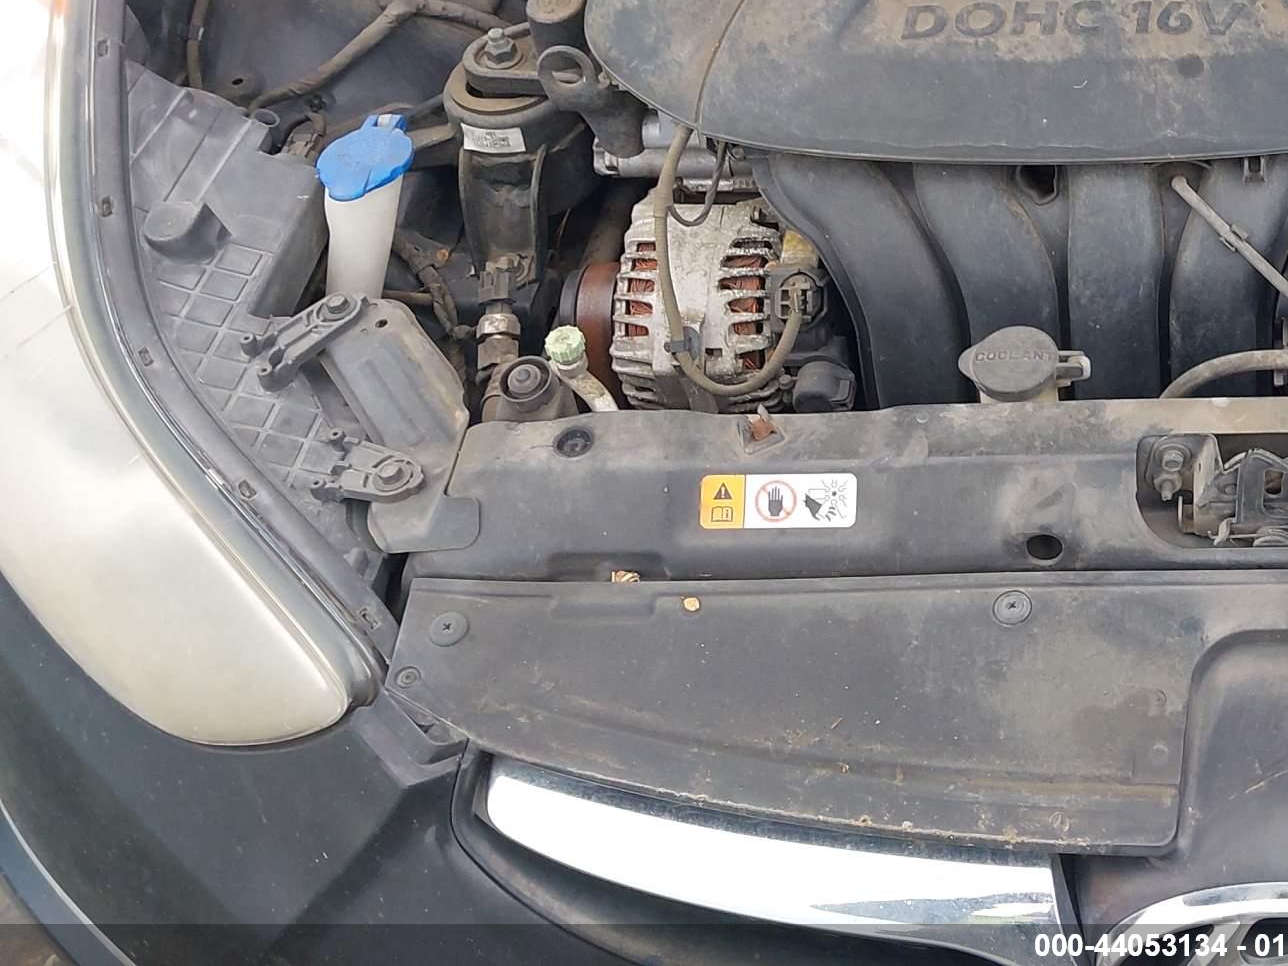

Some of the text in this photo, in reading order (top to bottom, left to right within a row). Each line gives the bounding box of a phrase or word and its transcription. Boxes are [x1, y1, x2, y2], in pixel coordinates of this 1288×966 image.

[900, 0, 1246, 40] DOHC 16V
[975, 349, 1055, 363] COOLANT
